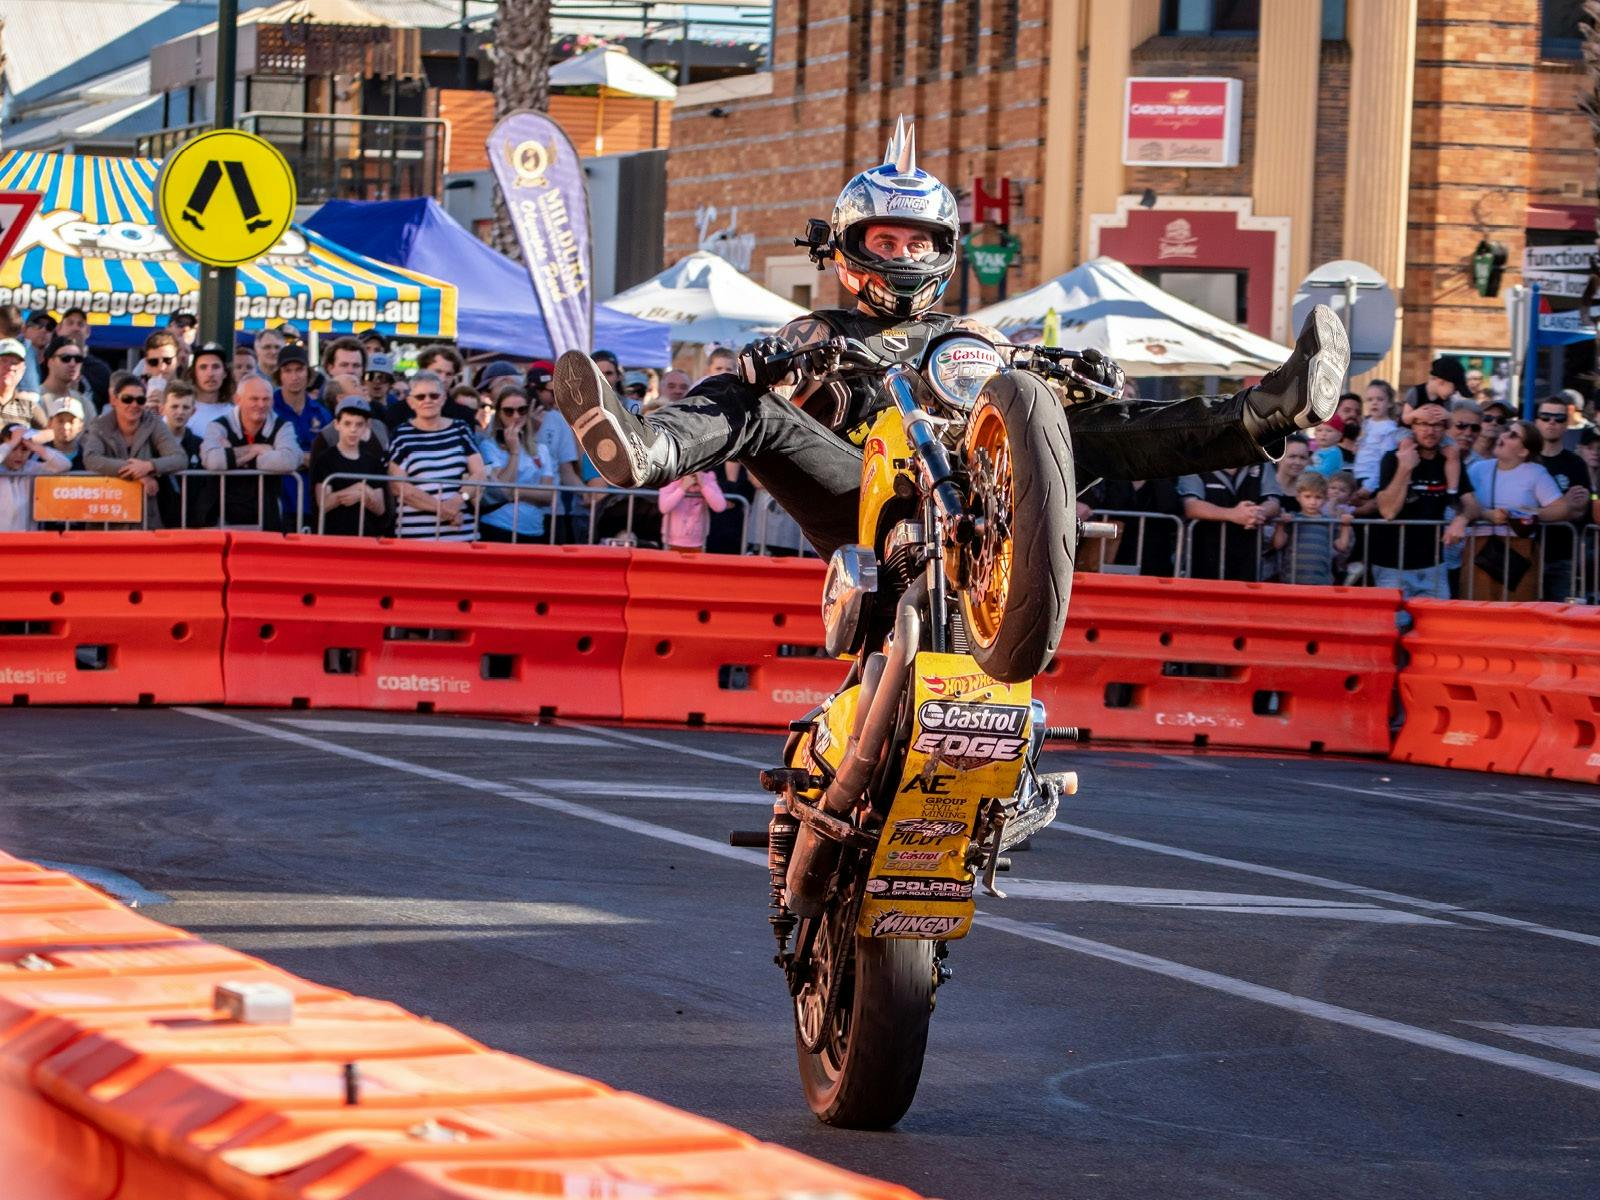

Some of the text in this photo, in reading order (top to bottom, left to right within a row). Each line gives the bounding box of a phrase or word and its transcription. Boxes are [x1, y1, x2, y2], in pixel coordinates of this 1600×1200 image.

[545, 187, 588, 295] MILDURA
[953, 350, 996, 363] Castrol
[944, 707, 1018, 731] Castrol
[912, 732, 1025, 761] EDGE
[900, 773, 956, 795] AE
[923, 803, 953, 812] CIVIL
[925, 797, 967, 806] GROUP
[921, 810, 967, 819] MINING
[900, 851, 939, 861] Castrol
[881, 861, 941, 872] EDGE
[892, 880, 972, 893] POLARIS
[874, 911, 967, 938] MINGAY
